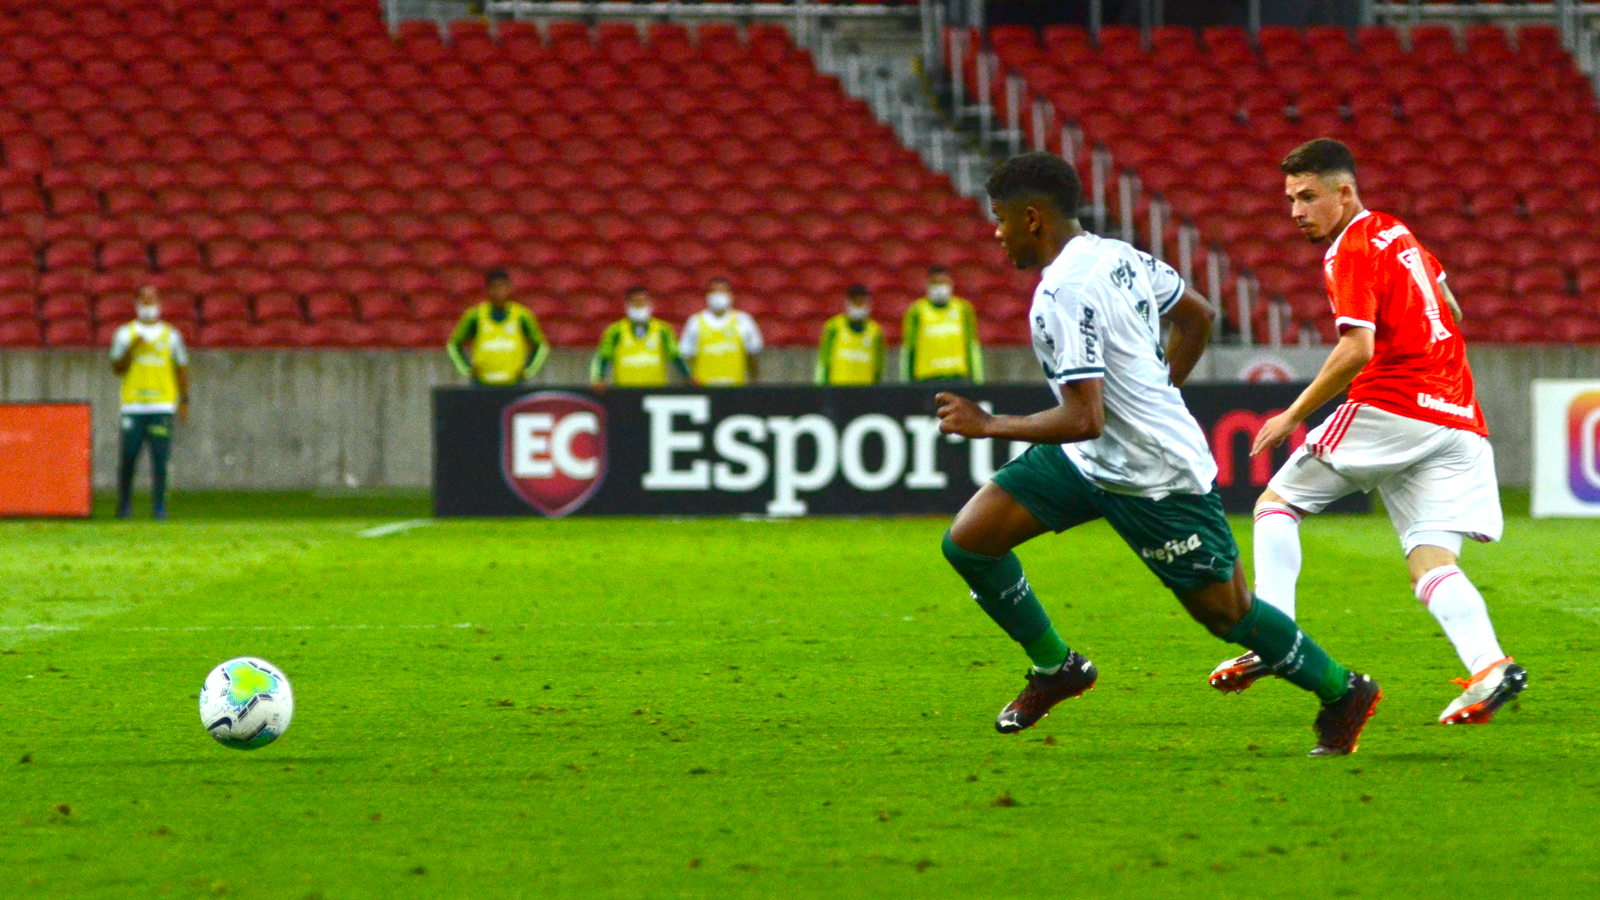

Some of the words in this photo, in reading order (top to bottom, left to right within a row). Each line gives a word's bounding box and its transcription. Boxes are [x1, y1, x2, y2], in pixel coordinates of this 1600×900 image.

[1417, 392, 1474, 419] Unimed
[512, 411, 600, 480] EC
[641, 394, 1032, 516] Esport
[1142, 533, 1202, 564] crefisa
